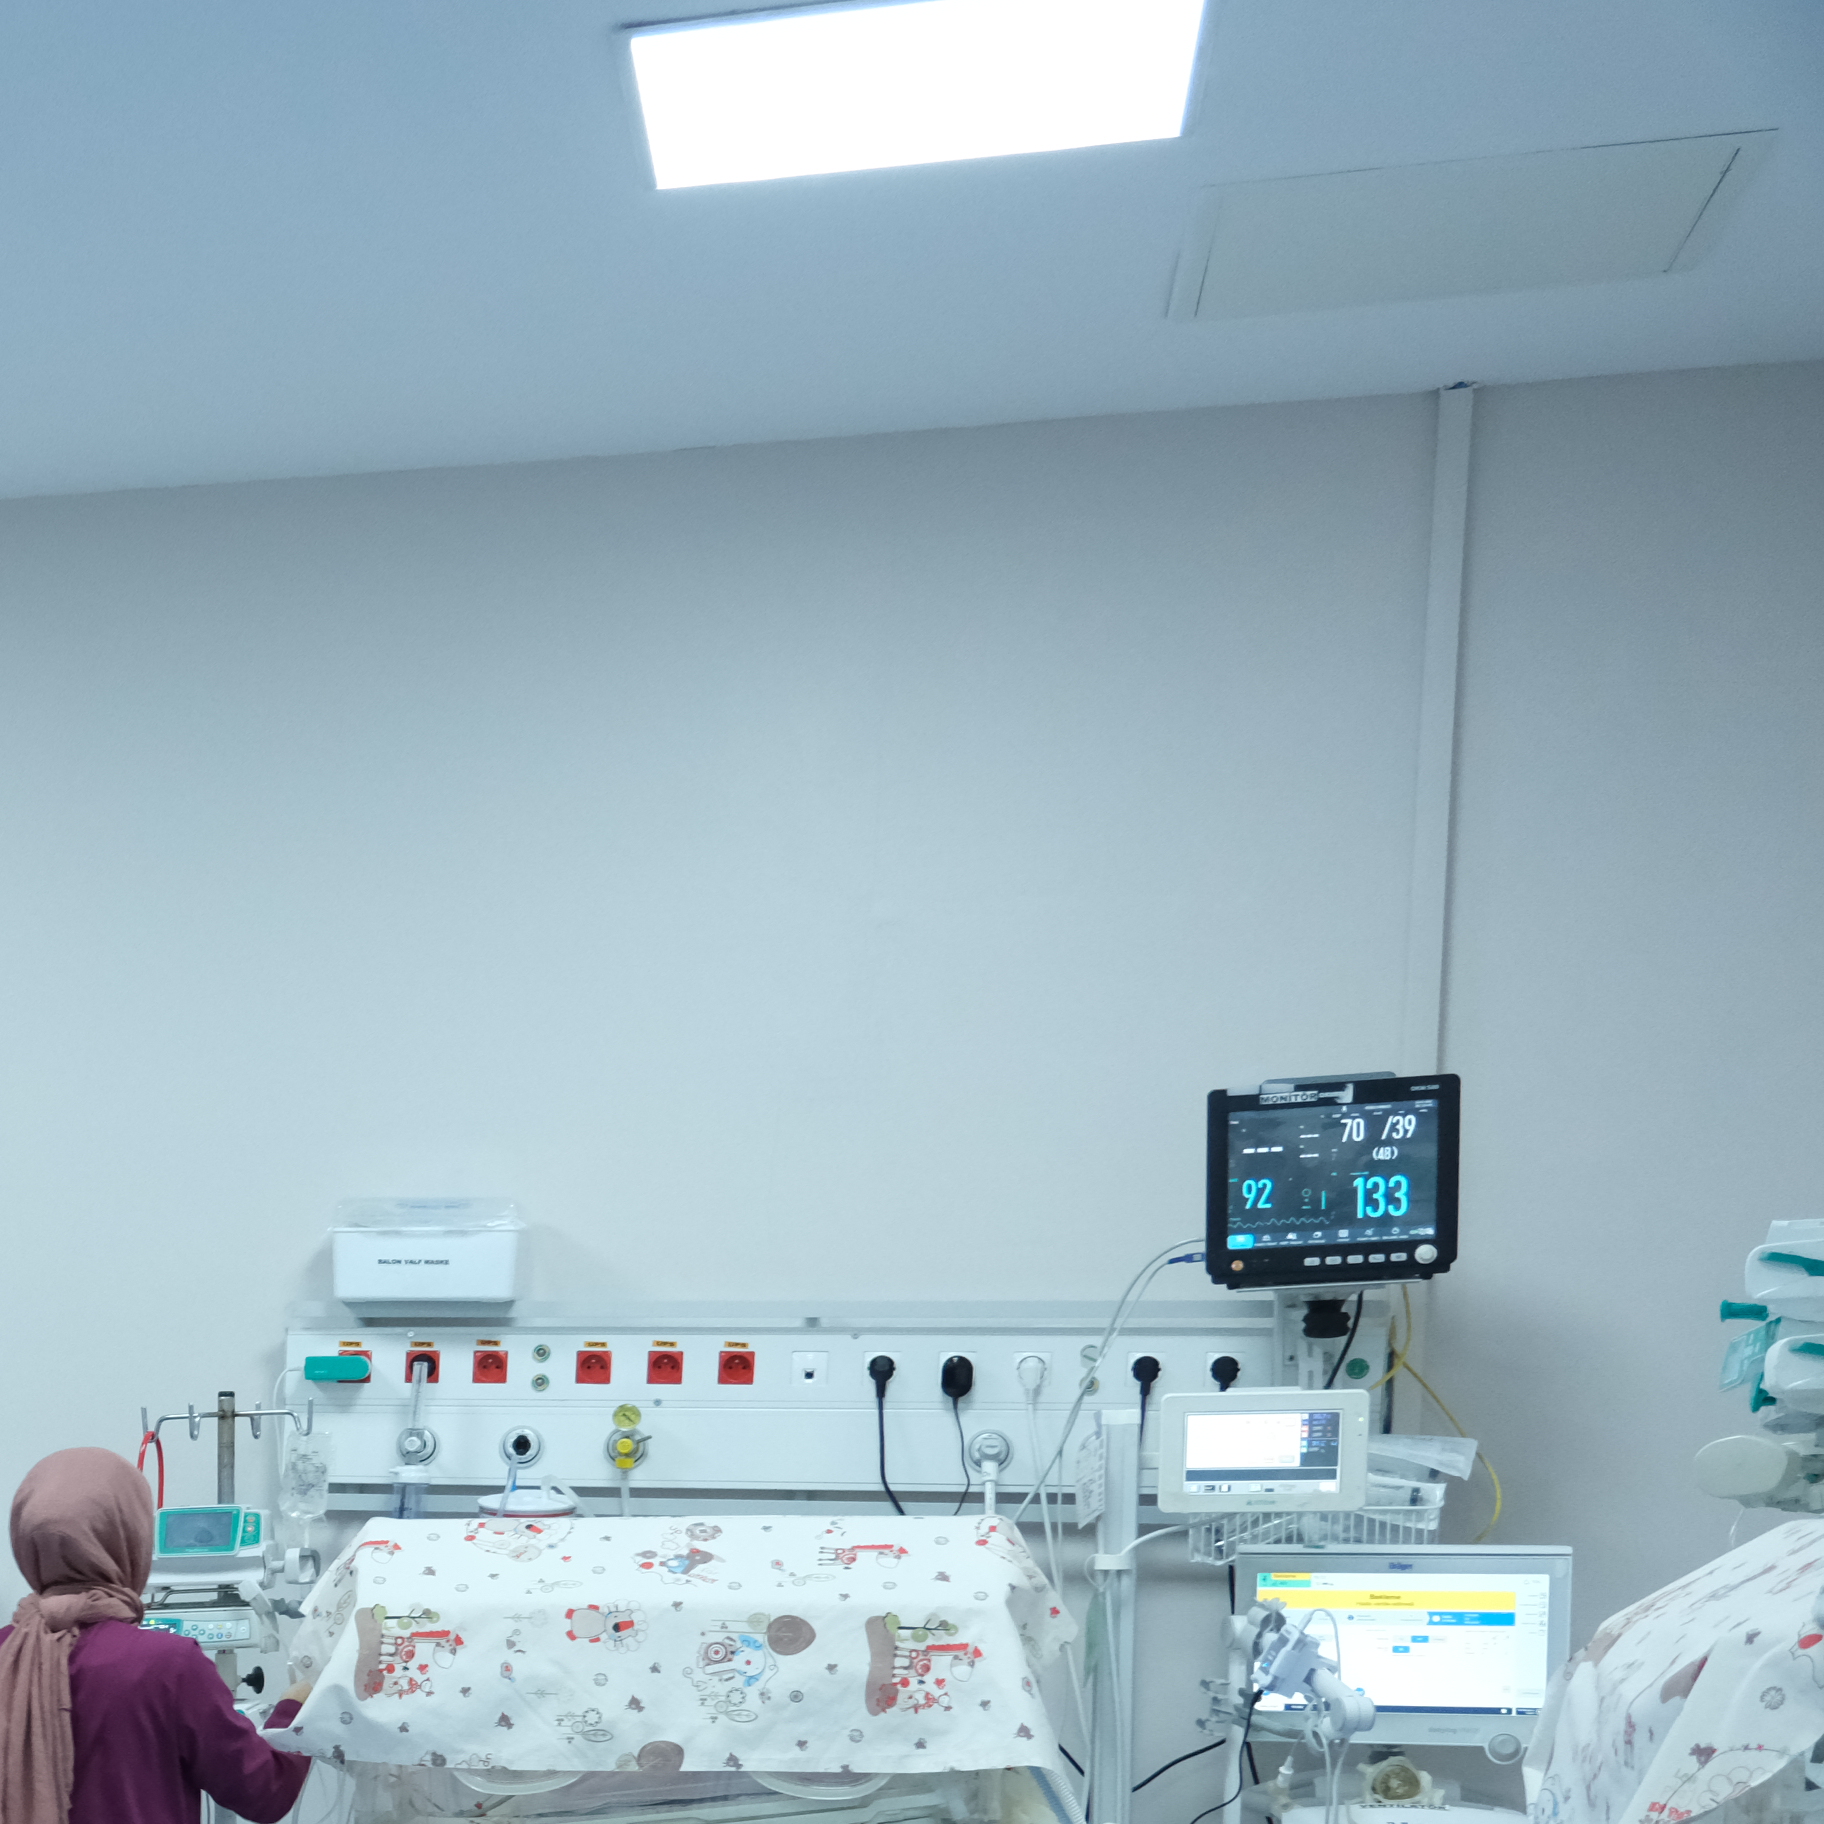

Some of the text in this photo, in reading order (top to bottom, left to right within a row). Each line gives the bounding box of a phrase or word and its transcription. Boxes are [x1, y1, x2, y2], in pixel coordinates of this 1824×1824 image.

[1340, 1115, 1417, 1143] 70 /39
[1242, 1178, 1273, 1210] 92
[1352, 1174, 1410, 1219] 133
